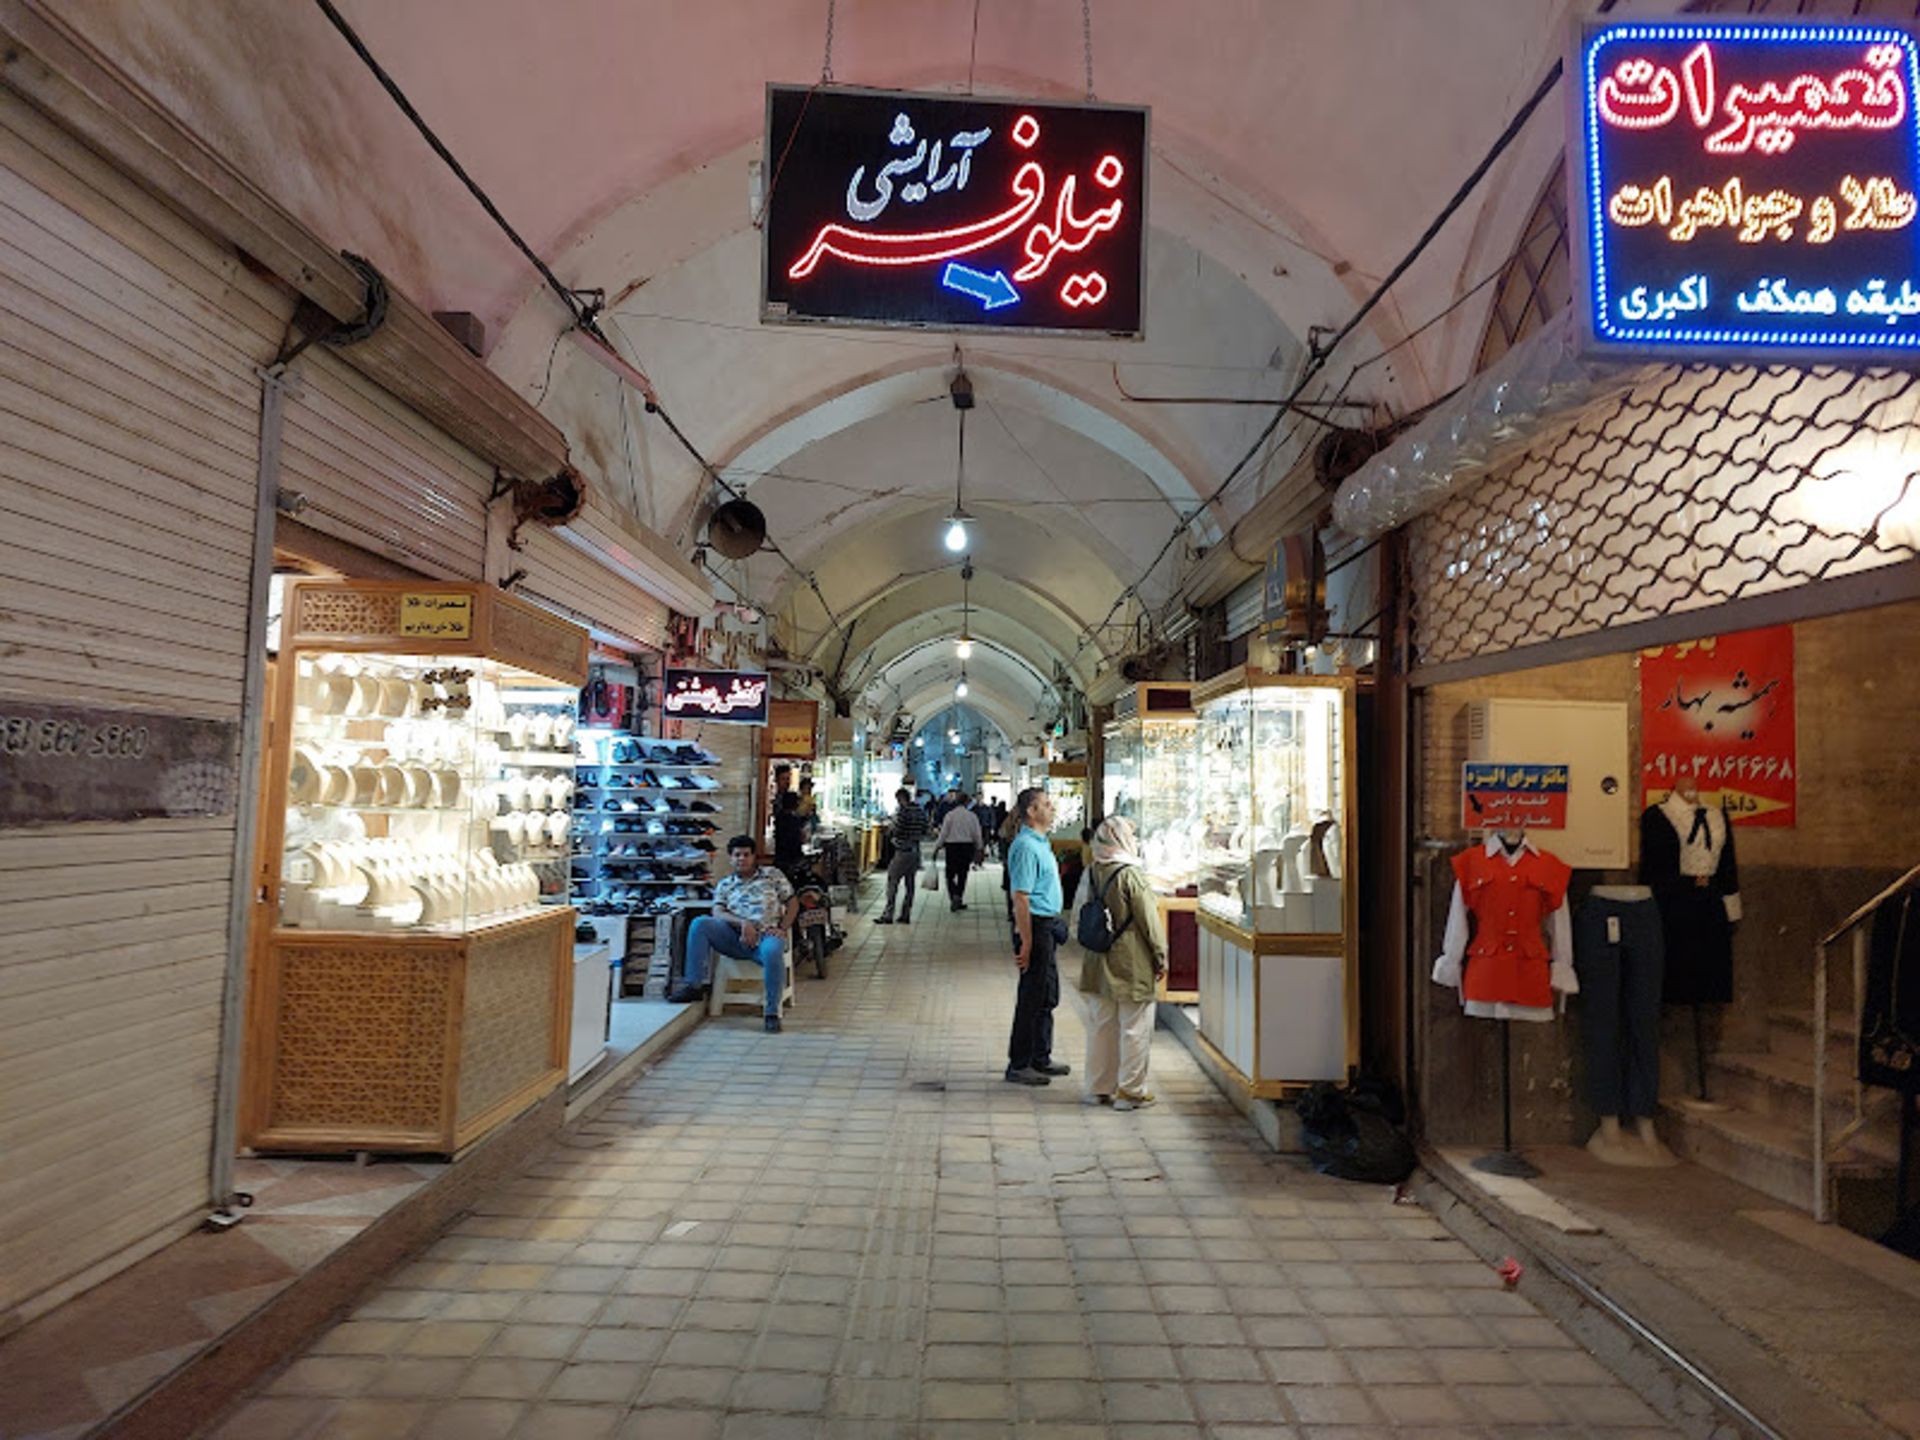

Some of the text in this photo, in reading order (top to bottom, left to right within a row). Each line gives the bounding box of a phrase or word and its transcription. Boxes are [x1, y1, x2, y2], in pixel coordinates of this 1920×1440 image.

[1599, 41, 1905, 152] تعمیرات
[846, 112, 992, 221] آرایشی
[789, 113, 1123, 306] نیلوفر
[1609, 174, 1918, 243] طلا و جواهرات
[1619, 274, 1709, 320] اکبری
[1736, 277, 1838, 314] همکف
[1540, 767, 1567, 789] مانتو
